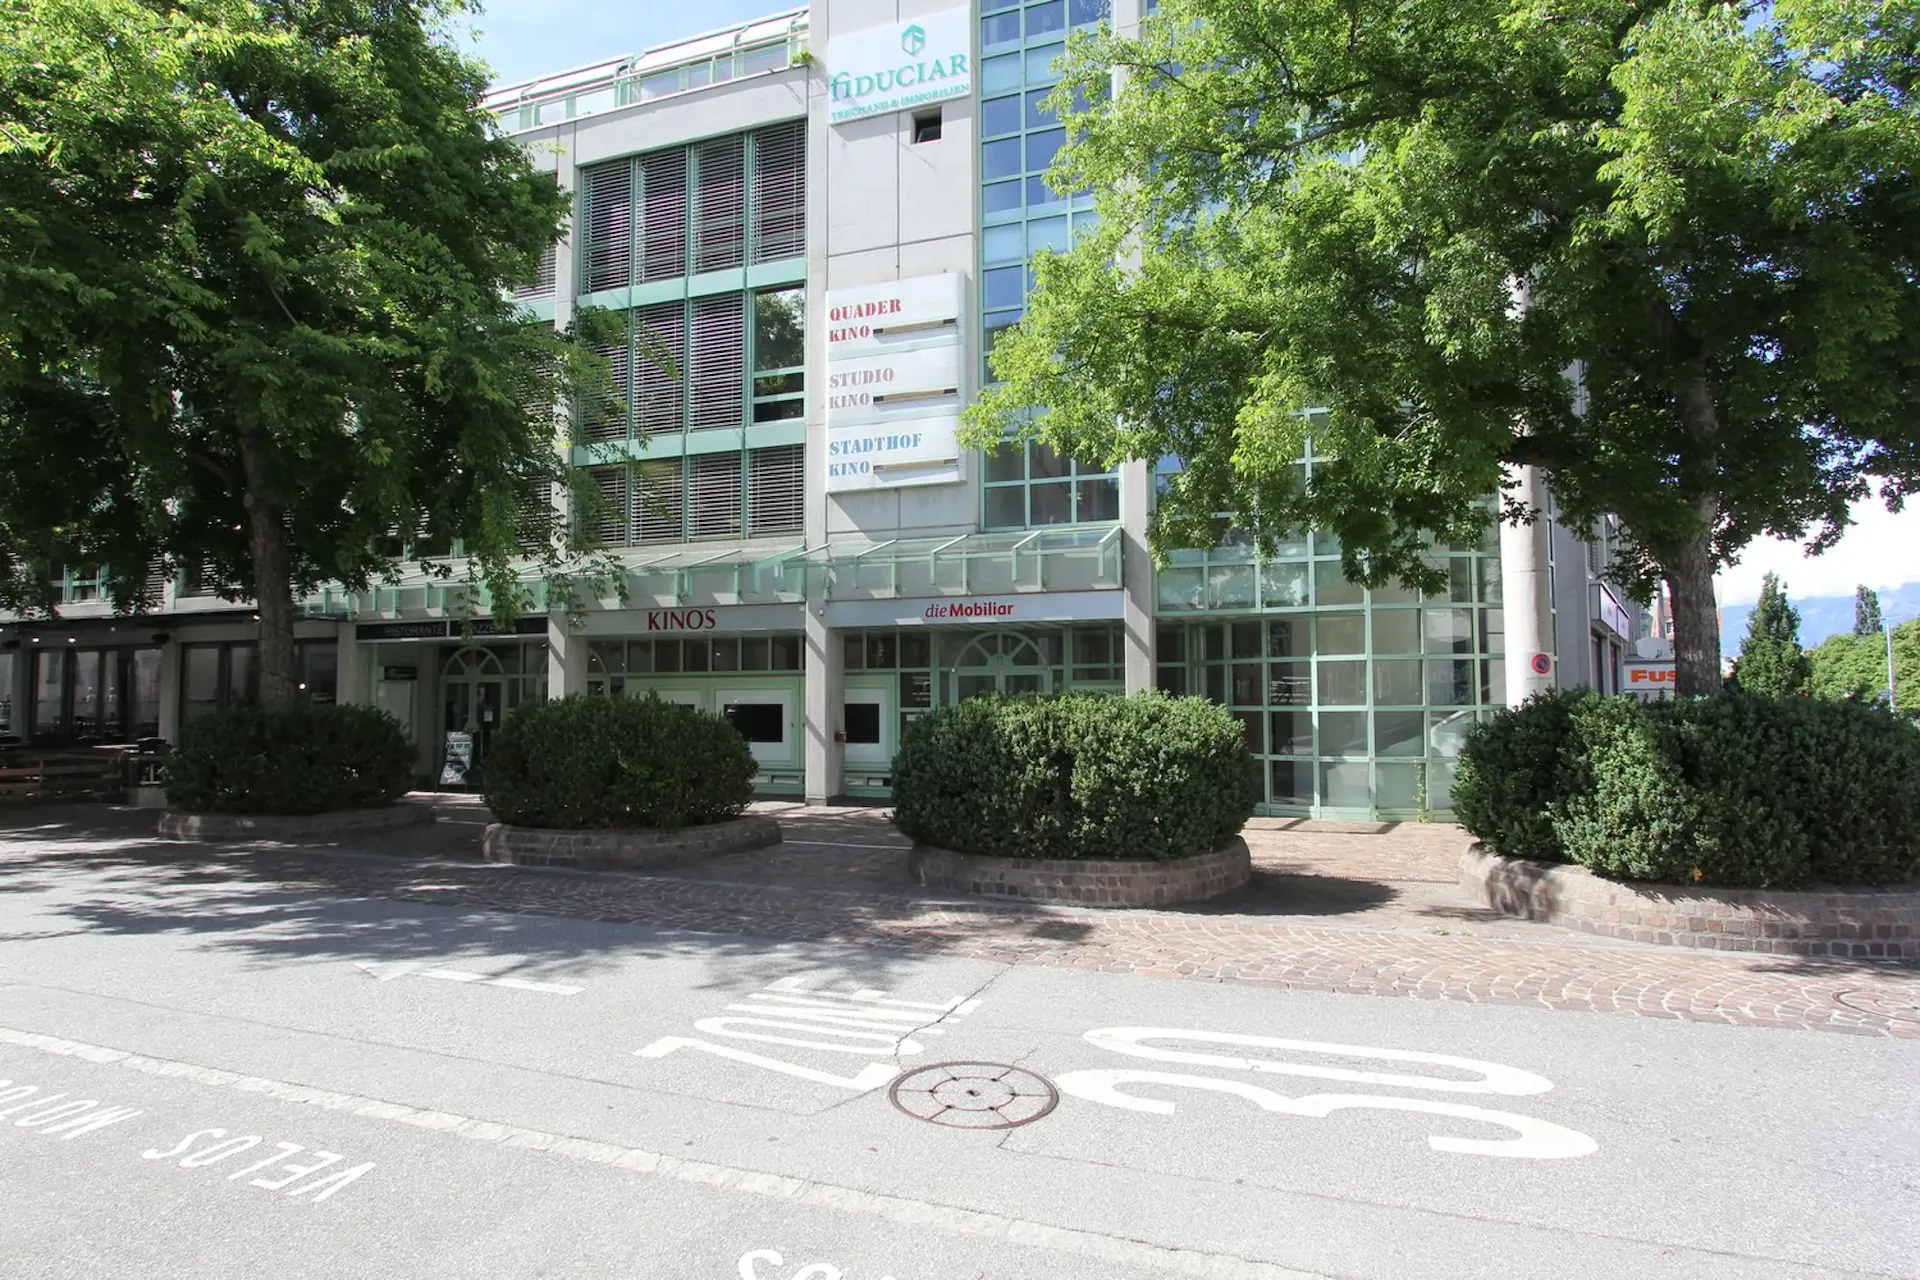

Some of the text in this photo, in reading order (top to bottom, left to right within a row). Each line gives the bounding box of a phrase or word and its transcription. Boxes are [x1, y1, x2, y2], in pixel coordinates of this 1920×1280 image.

[829, 298, 902, 322] QUADER
[829, 324, 871, 343] KINO
[829, 367, 894, 389] STUDIO
[829, 392, 870, 410] KINO
[829, 433, 923, 456] STADTHOF
[829, 460, 871, 477] KINO
[648, 609, 716, 631] KINOS
[925, 600, 1014, 618] die Mobiliar
[384, 623, 445, 638] RISTORANTE
[632, 976, 984, 1091] ZONE
[1056, 1025, 1598, 1160] 30
[142, 1127, 377, 1202] VELOS
